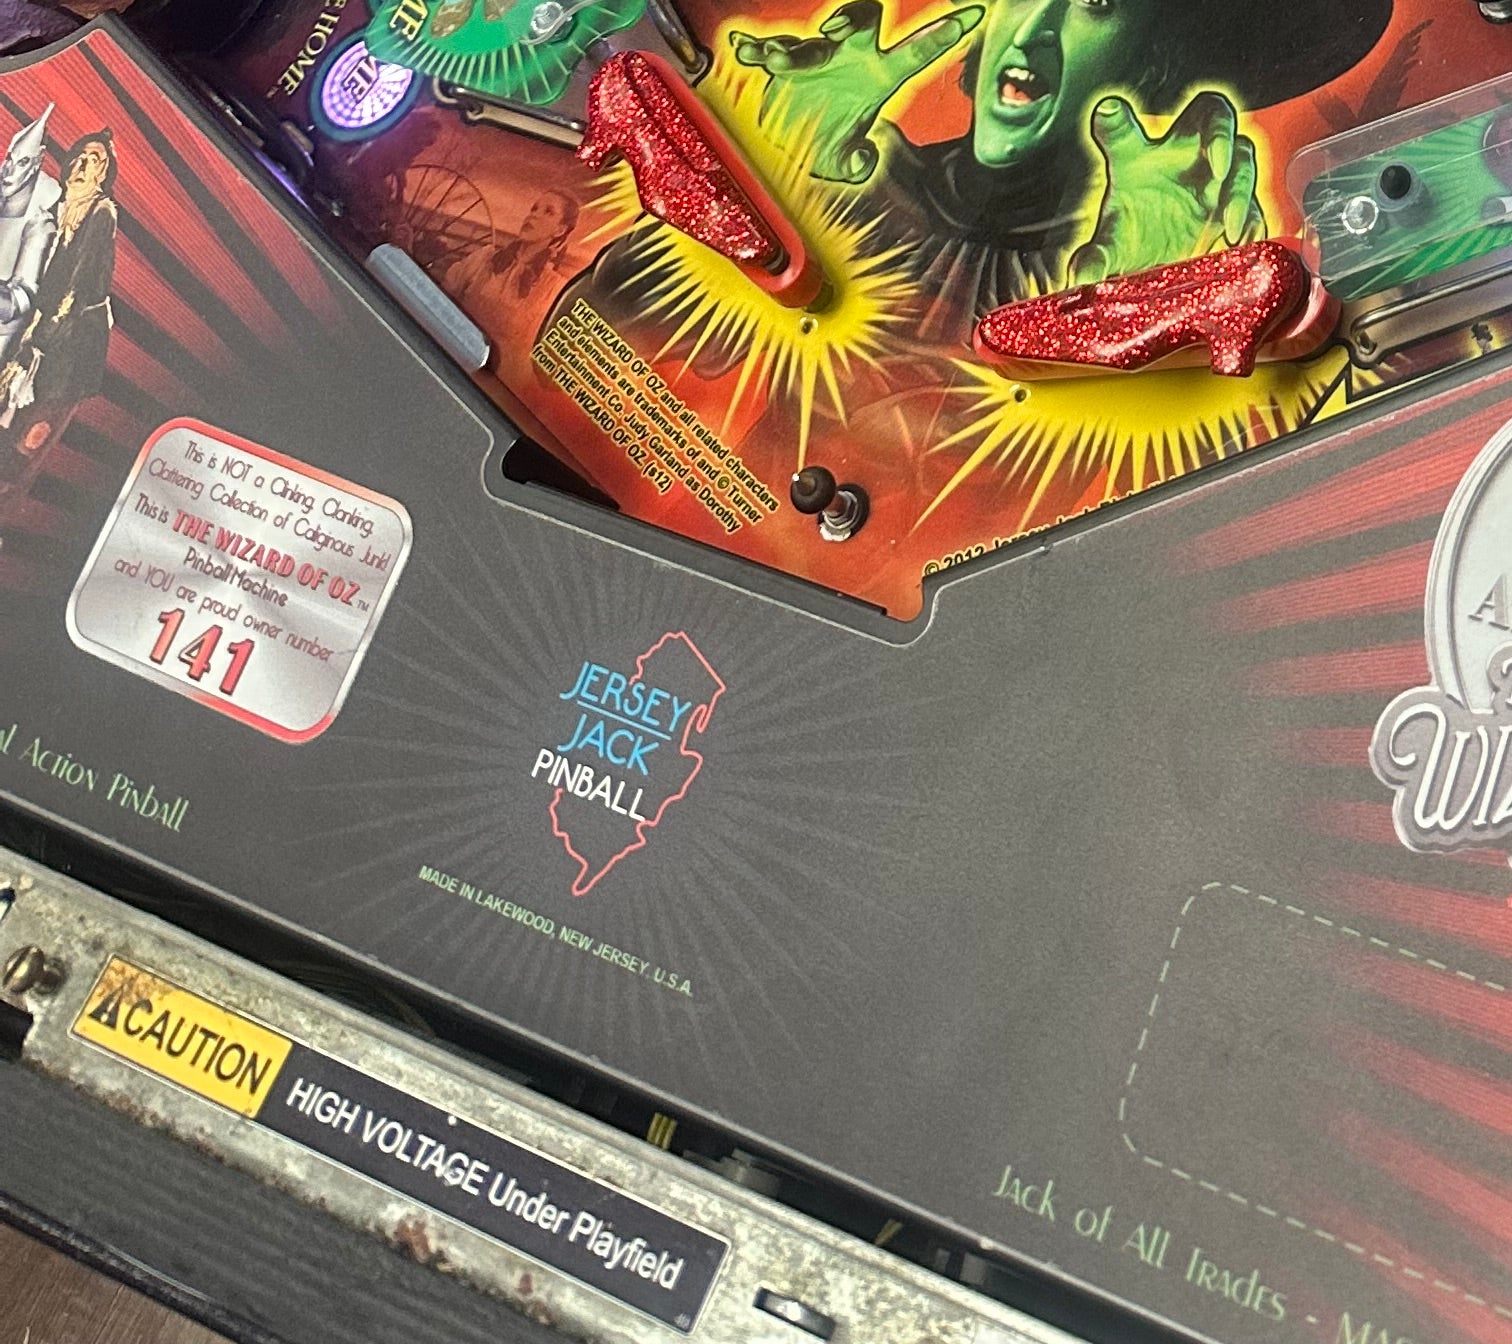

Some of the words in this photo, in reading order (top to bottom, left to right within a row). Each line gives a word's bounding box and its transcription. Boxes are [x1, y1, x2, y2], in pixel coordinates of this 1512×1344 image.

[277, 11, 340, 97] HOME
[531, 343, 556, 375] from
[553, 368, 578, 395] THE
[573, 389, 616, 435] WIZARD
[611, 428, 632, 449] OF
[544, 329, 611, 401] Entertainment
[624, 412, 651, 442] Judy
[647, 434, 690, 480] Garland
[685, 474, 701, 492] as
[697, 486, 743, 534] Dorothy
[557, 315, 580, 339] and
[576, 334, 620, 381] elements
[616, 377, 636, 398] are
[633, 392, 688, 451] trademarks
[686, 445, 701, 461] of
[696, 456, 720, 481] and
[725, 484, 764, 525] Turner
[571, 299, 595, 325] THE
[591, 318, 634, 364] WIZARD
[630, 359, 650, 377] OF
[645, 375, 666, 395] OZ
[659, 391, 683, 414] and
[678, 409, 696, 427] all
[692, 421, 729, 460] related
[725, 452, 779, 512] characters
[149, 457, 205, 500] Clattering
[209, 482, 269, 523] Collection
[273, 510, 291, 531] of
[184, 439, 206, 466] This
[206, 451, 218, 470] is
[219, 456, 254, 482] NOT
[134, 492, 158, 520] This
[172, 507, 215, 545] THE
[214, 525, 296, 579] WIZARD
[297, 561, 330, 592] OF
[183, 545, 231, 587] Pinball
[226, 567, 289, 608] Machine
[113, 556, 138, 579] and
[144, 565, 175, 594] YOU
[175, 582, 198, 604] are
[197, 594, 241, 628] proud
[242, 613, 283, 642] owner
[285, 630, 335, 662] number
[149, 607, 255, 696] 141
[559, 660, 692, 733] JERSEY
[530, 747, 647, 823] PINBALL
[556, 713, 660, 776] JACK
[106, 772, 190, 833] Pinball
[418, 864, 457, 895] MADE
[457, 881, 475, 901] IN
[474, 889, 557, 939] LAKEWOOD,
[558, 925, 594, 953] NEW
[122, 999, 273, 1098] CAUTION
[286, 1077, 362, 1134] HIGH
[361, 1110, 489, 1197] VOLTAGE
[488, 1176, 572, 1235] Under
[567, 1211, 685, 1291] Playfield
[992, 1164, 1056, 1222] Jack
[1073, 1204, 1113, 1244] of
[1121, 1222, 1171, 1271] All
[1185, 1246, 1287, 1322] Trades
